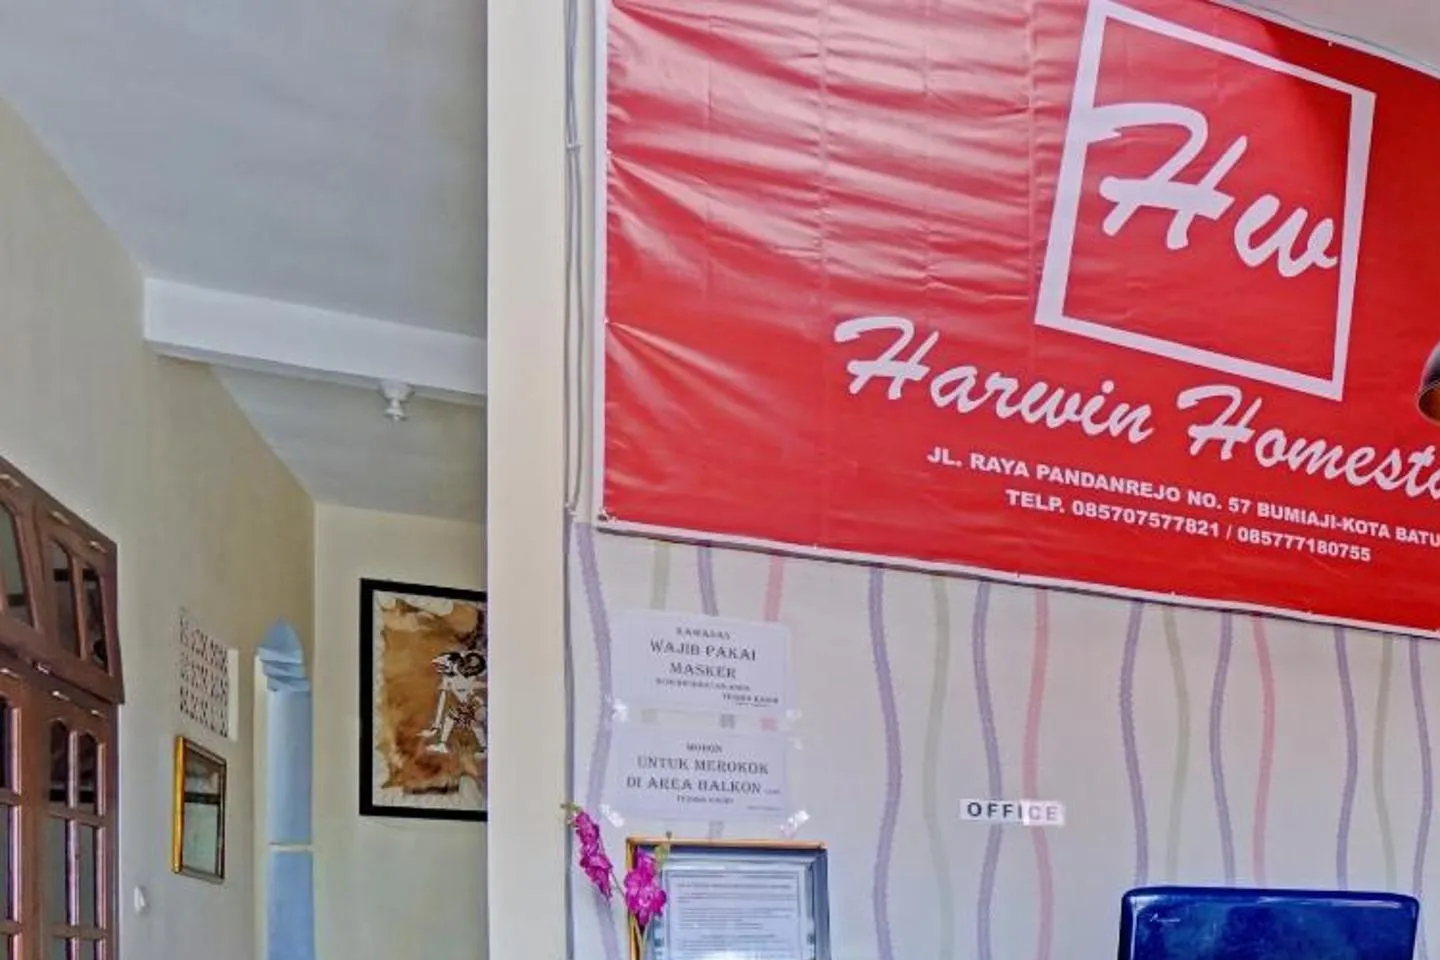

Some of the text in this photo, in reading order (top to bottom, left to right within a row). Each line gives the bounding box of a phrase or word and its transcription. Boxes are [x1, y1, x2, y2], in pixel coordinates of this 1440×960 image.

[1075, 102, 1339, 278] Hw
[833, 315, 1154, 446] Harwin
[927, 446, 962, 467] JL.
[970, 452, 1030, 478] RAYA
[1036, 464, 1181, 502] PANDANREJO
[1187, 489, 1222, 510] NO.
[1228, 496, 1252, 515] 57
[1257, 502, 1391, 540] BUMIAJI-KOTA
[1005, 488, 1065, 513] TELP.
[1072, 500, 1220, 538] 085707577821
[1237, 528, 1372, 562] 085777180755
[705, 644, 756, 661] PAKAI
[669, 661, 737, 680] MASKER
[637, 755, 769, 775] UNTUK MEROKOK
[626, 775, 642, 789] DI
[647, 776, 693, 791] AREA
[697, 779, 762, 794] BALKON
[966, 801, 1058, 821] OFFICE
